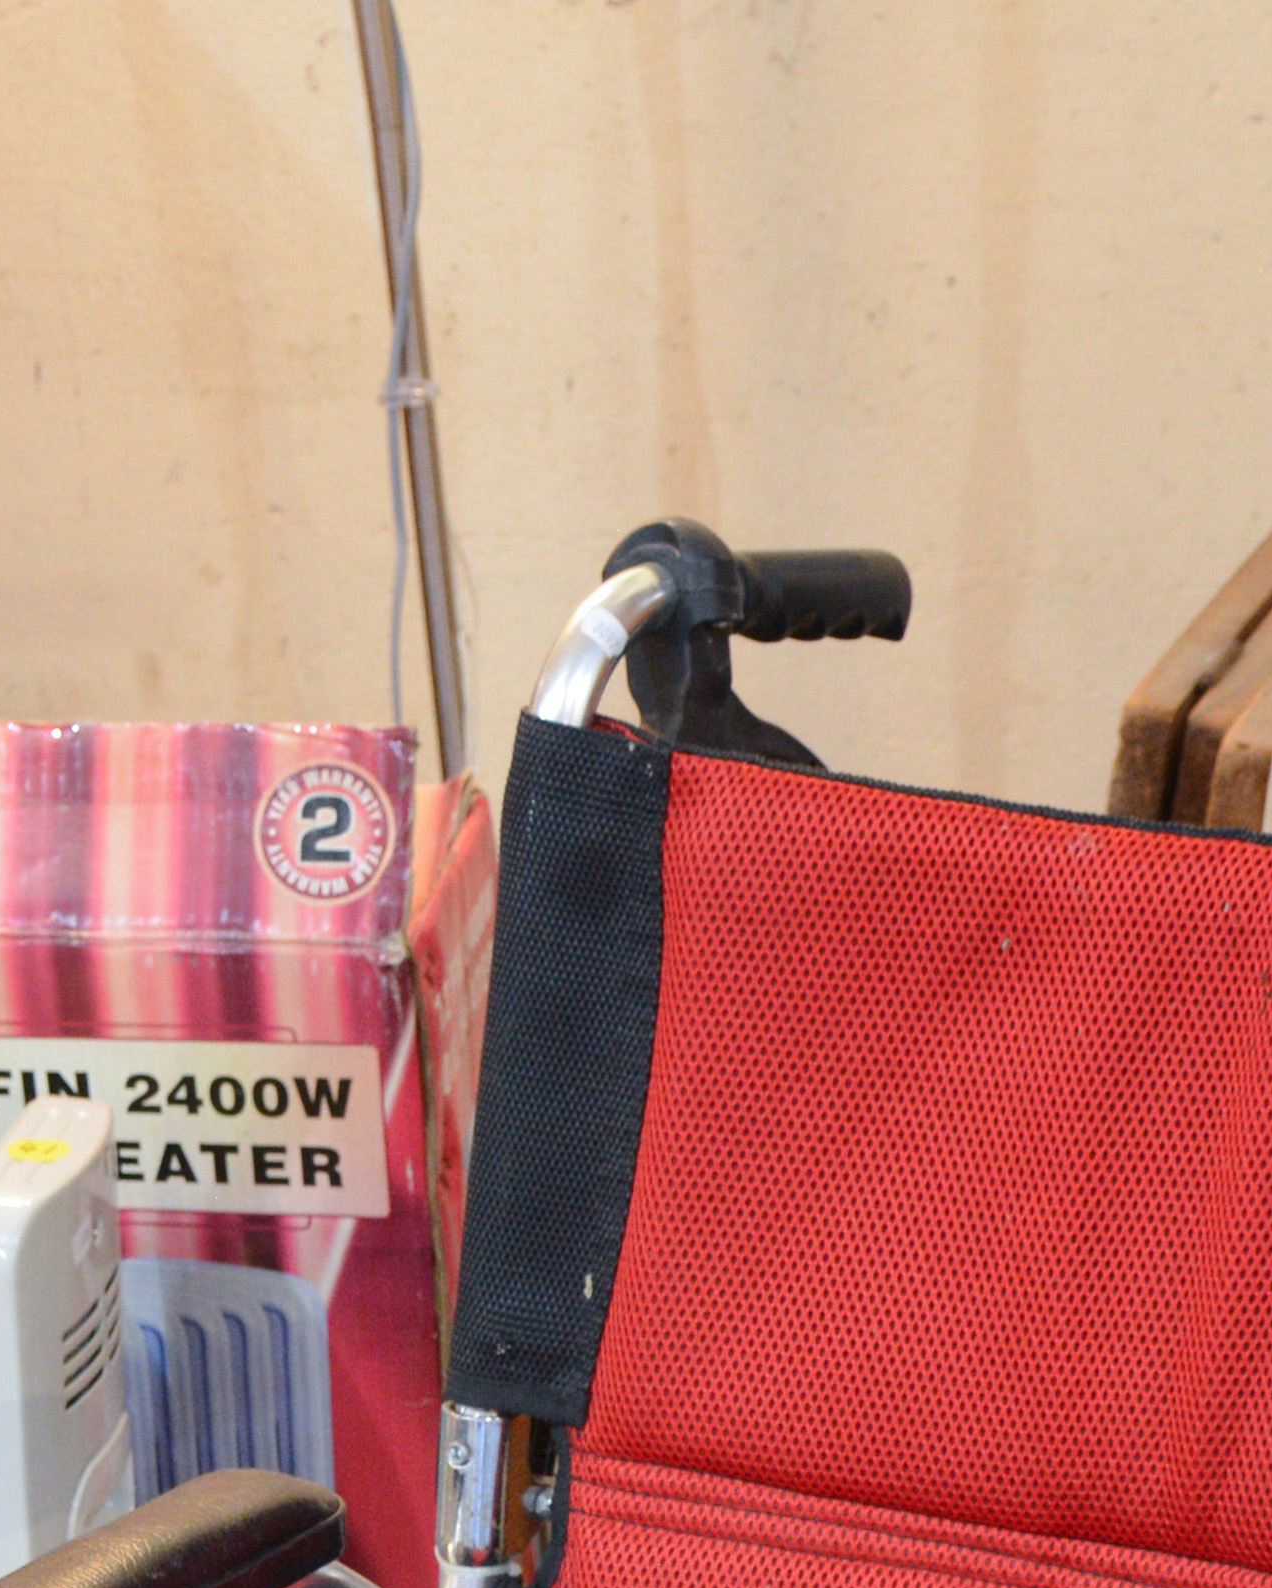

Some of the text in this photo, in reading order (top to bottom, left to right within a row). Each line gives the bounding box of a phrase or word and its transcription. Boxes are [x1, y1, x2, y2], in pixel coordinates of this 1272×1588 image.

[300, 794, 352, 863] 2
[125, 1073, 352, 1119] 2400W
[115, 1140, 343, 1188] EATER
